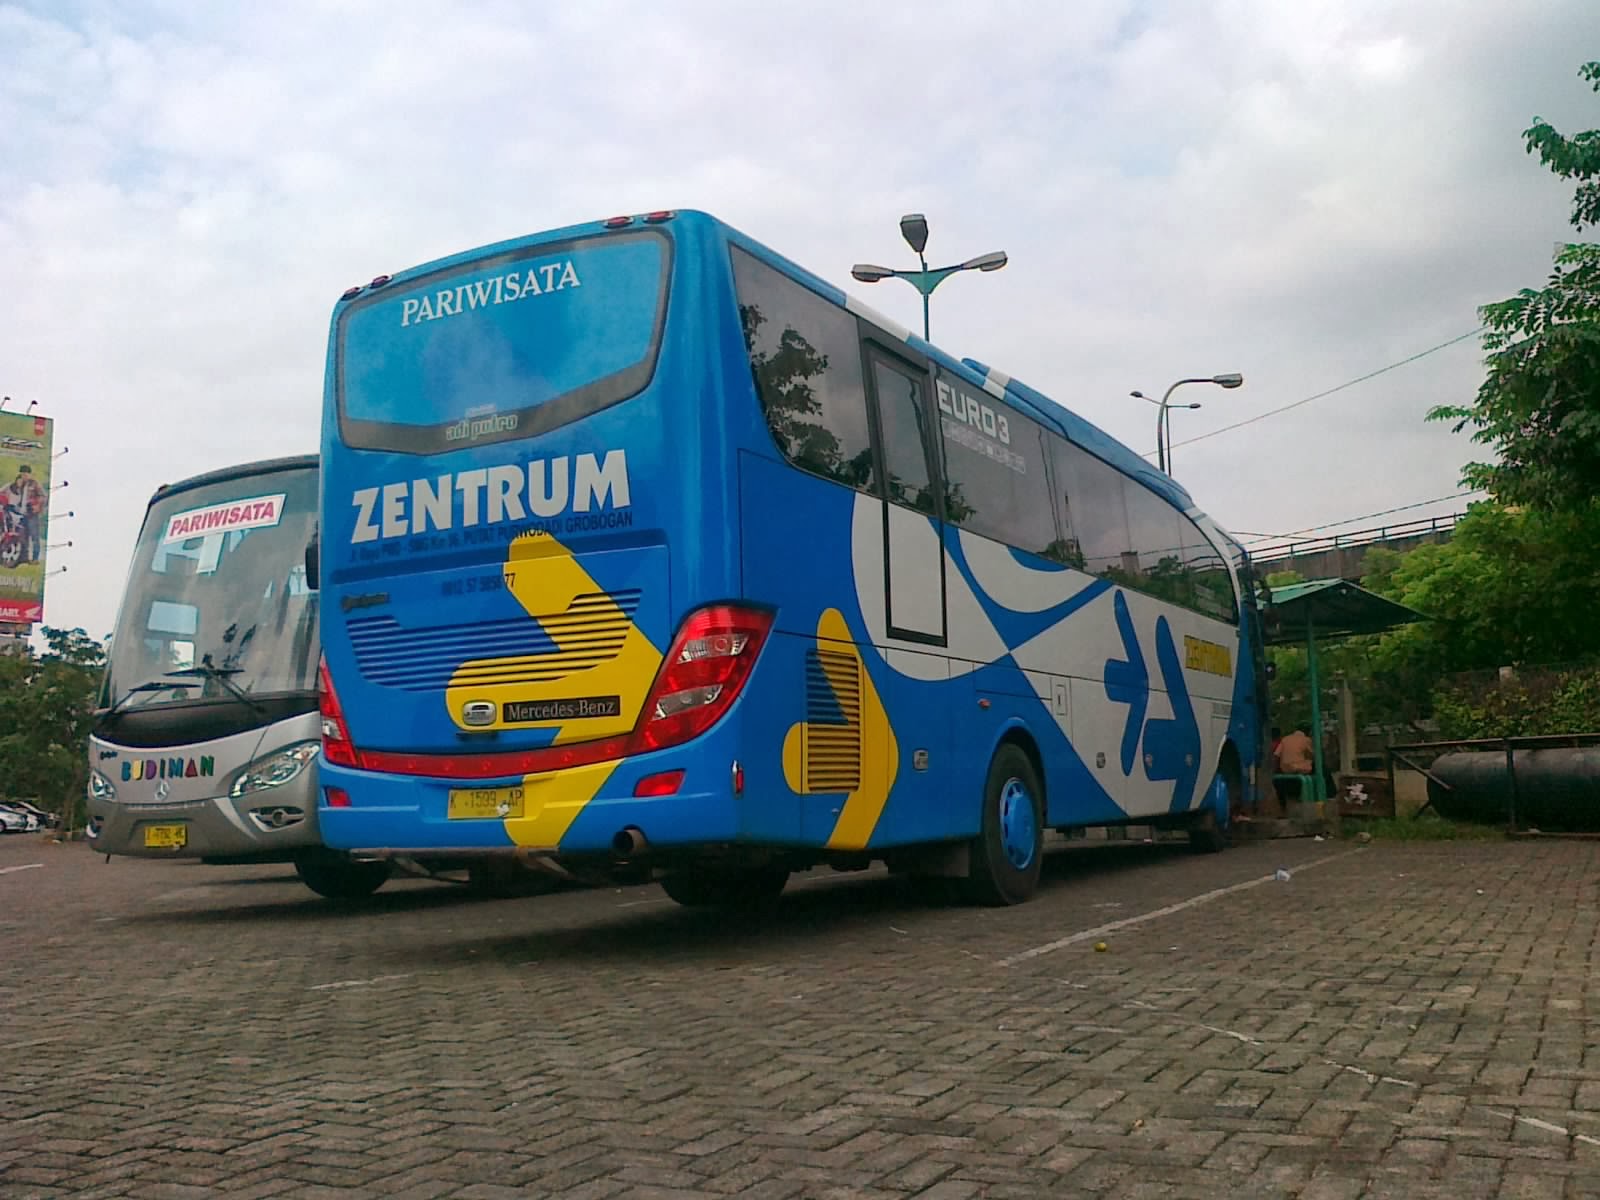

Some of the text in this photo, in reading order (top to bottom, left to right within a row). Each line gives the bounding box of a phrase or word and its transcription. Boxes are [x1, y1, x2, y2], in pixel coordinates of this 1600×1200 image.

[401, 262, 580, 326] PARIWISATA
[351, 449, 631, 543] ZENTRUM
[169, 499, 275, 538] PARIWISATA
[566, 511, 633, 535] GROBOGAN
[508, 698, 615, 720] Mercedes-Benz
[121, 755, 215, 782] BUDIMAN
